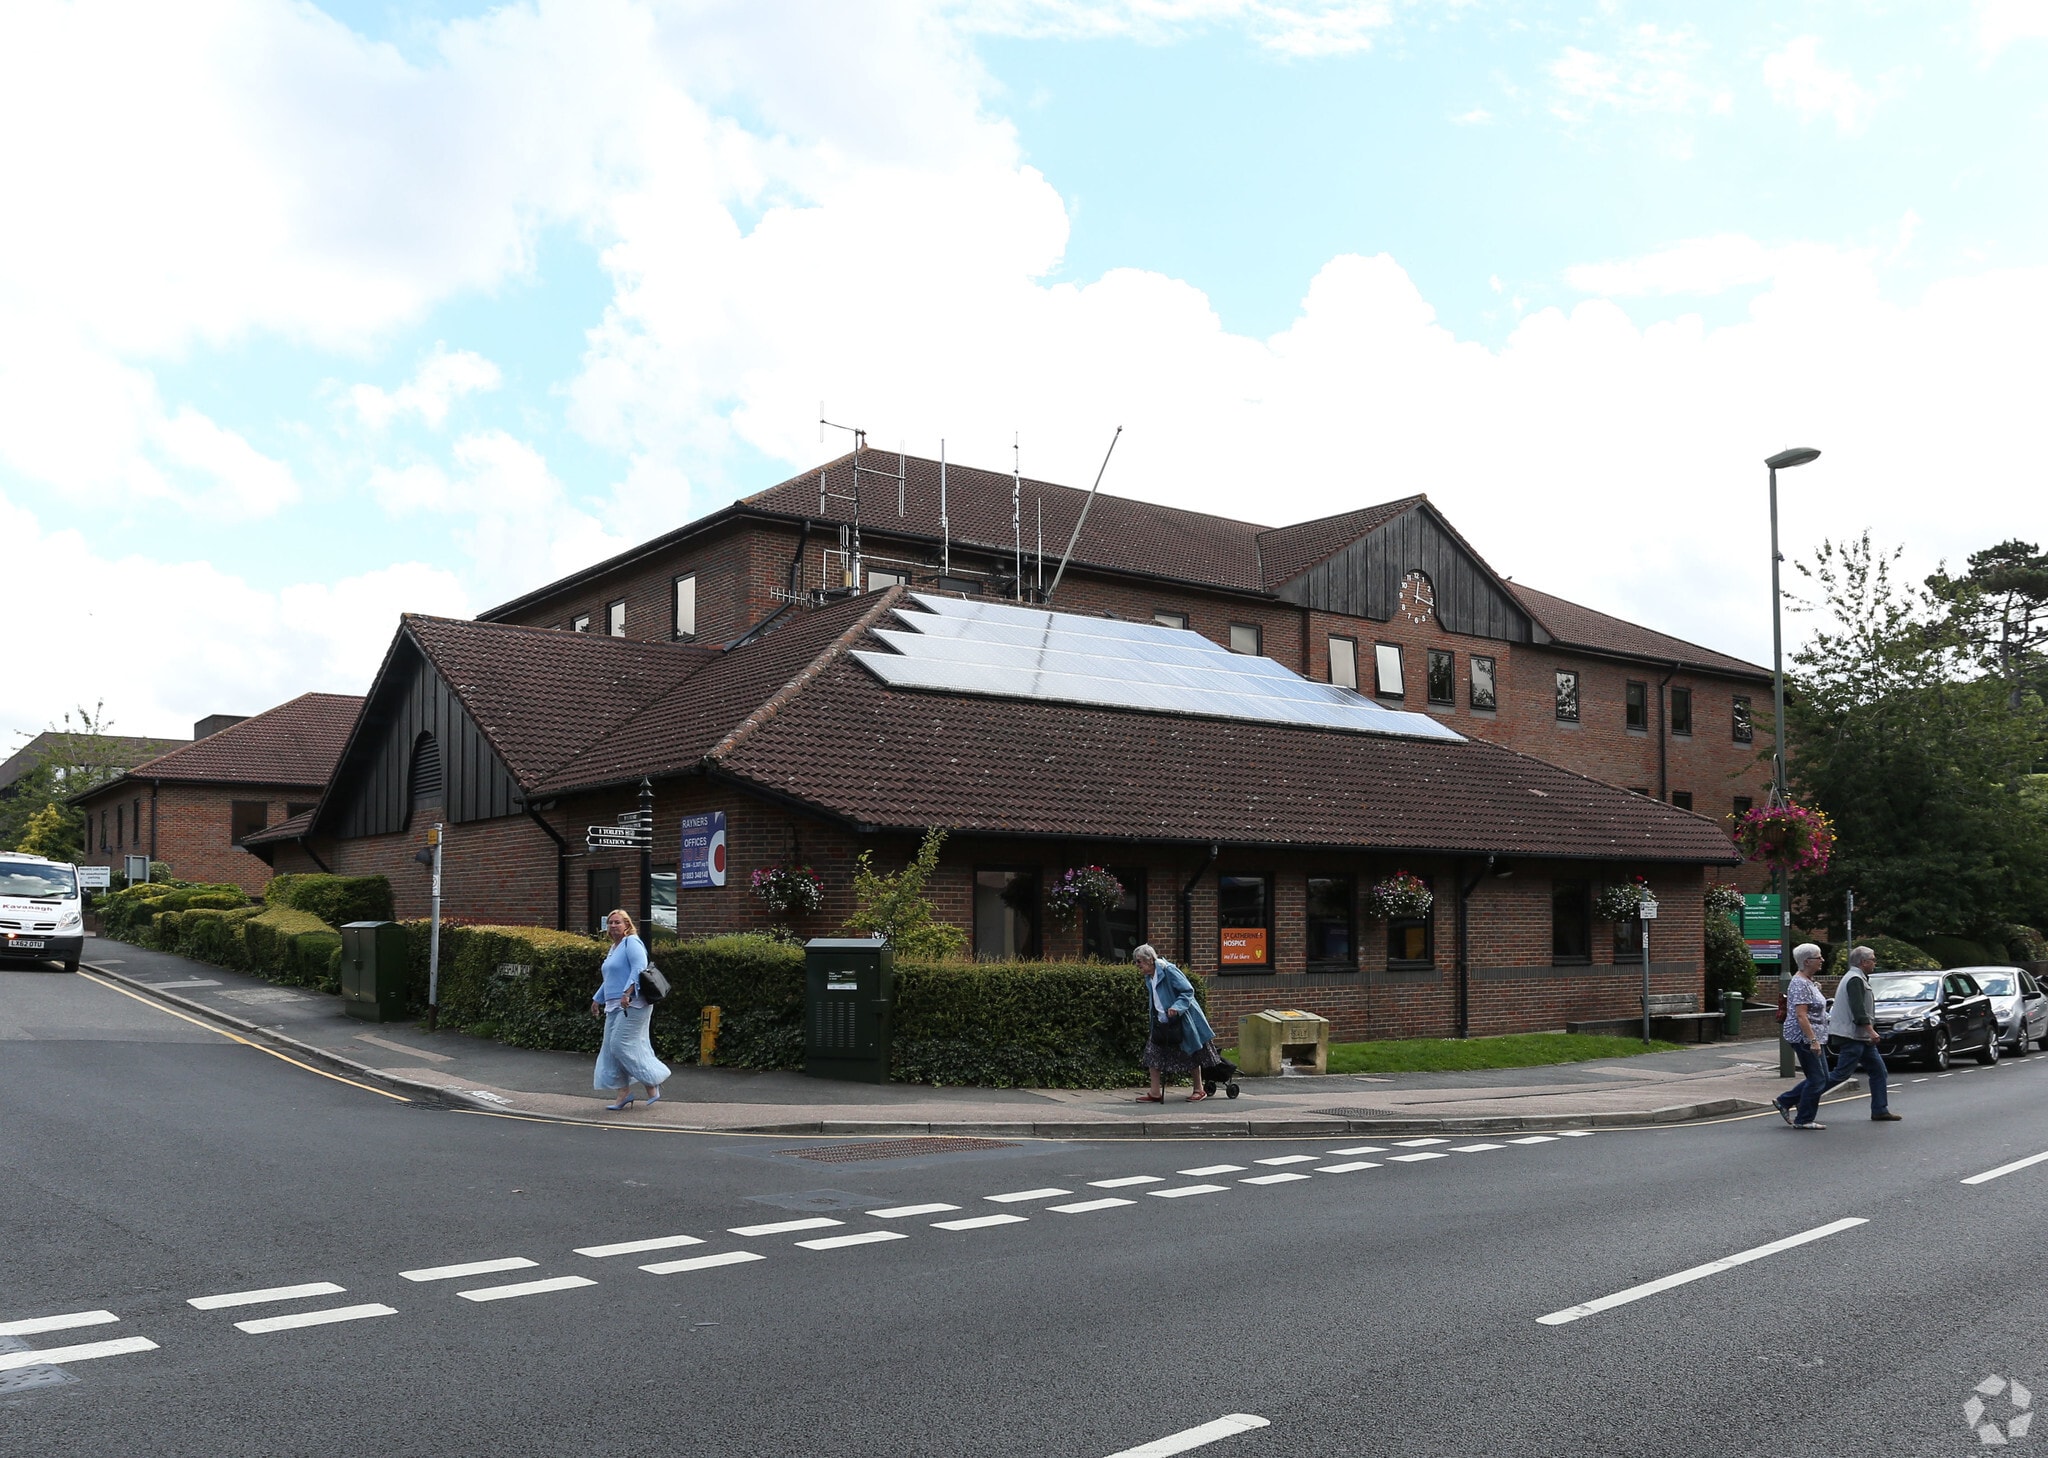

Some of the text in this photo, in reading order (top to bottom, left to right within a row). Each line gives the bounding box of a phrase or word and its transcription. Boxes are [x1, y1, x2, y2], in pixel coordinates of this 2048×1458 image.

[682, 817, 708, 828] RAYNERS
[684, 837, 707, 847] OFFICES
[683, 847, 708, 861] TO LET
[702, 1011, 711, 1029] H
